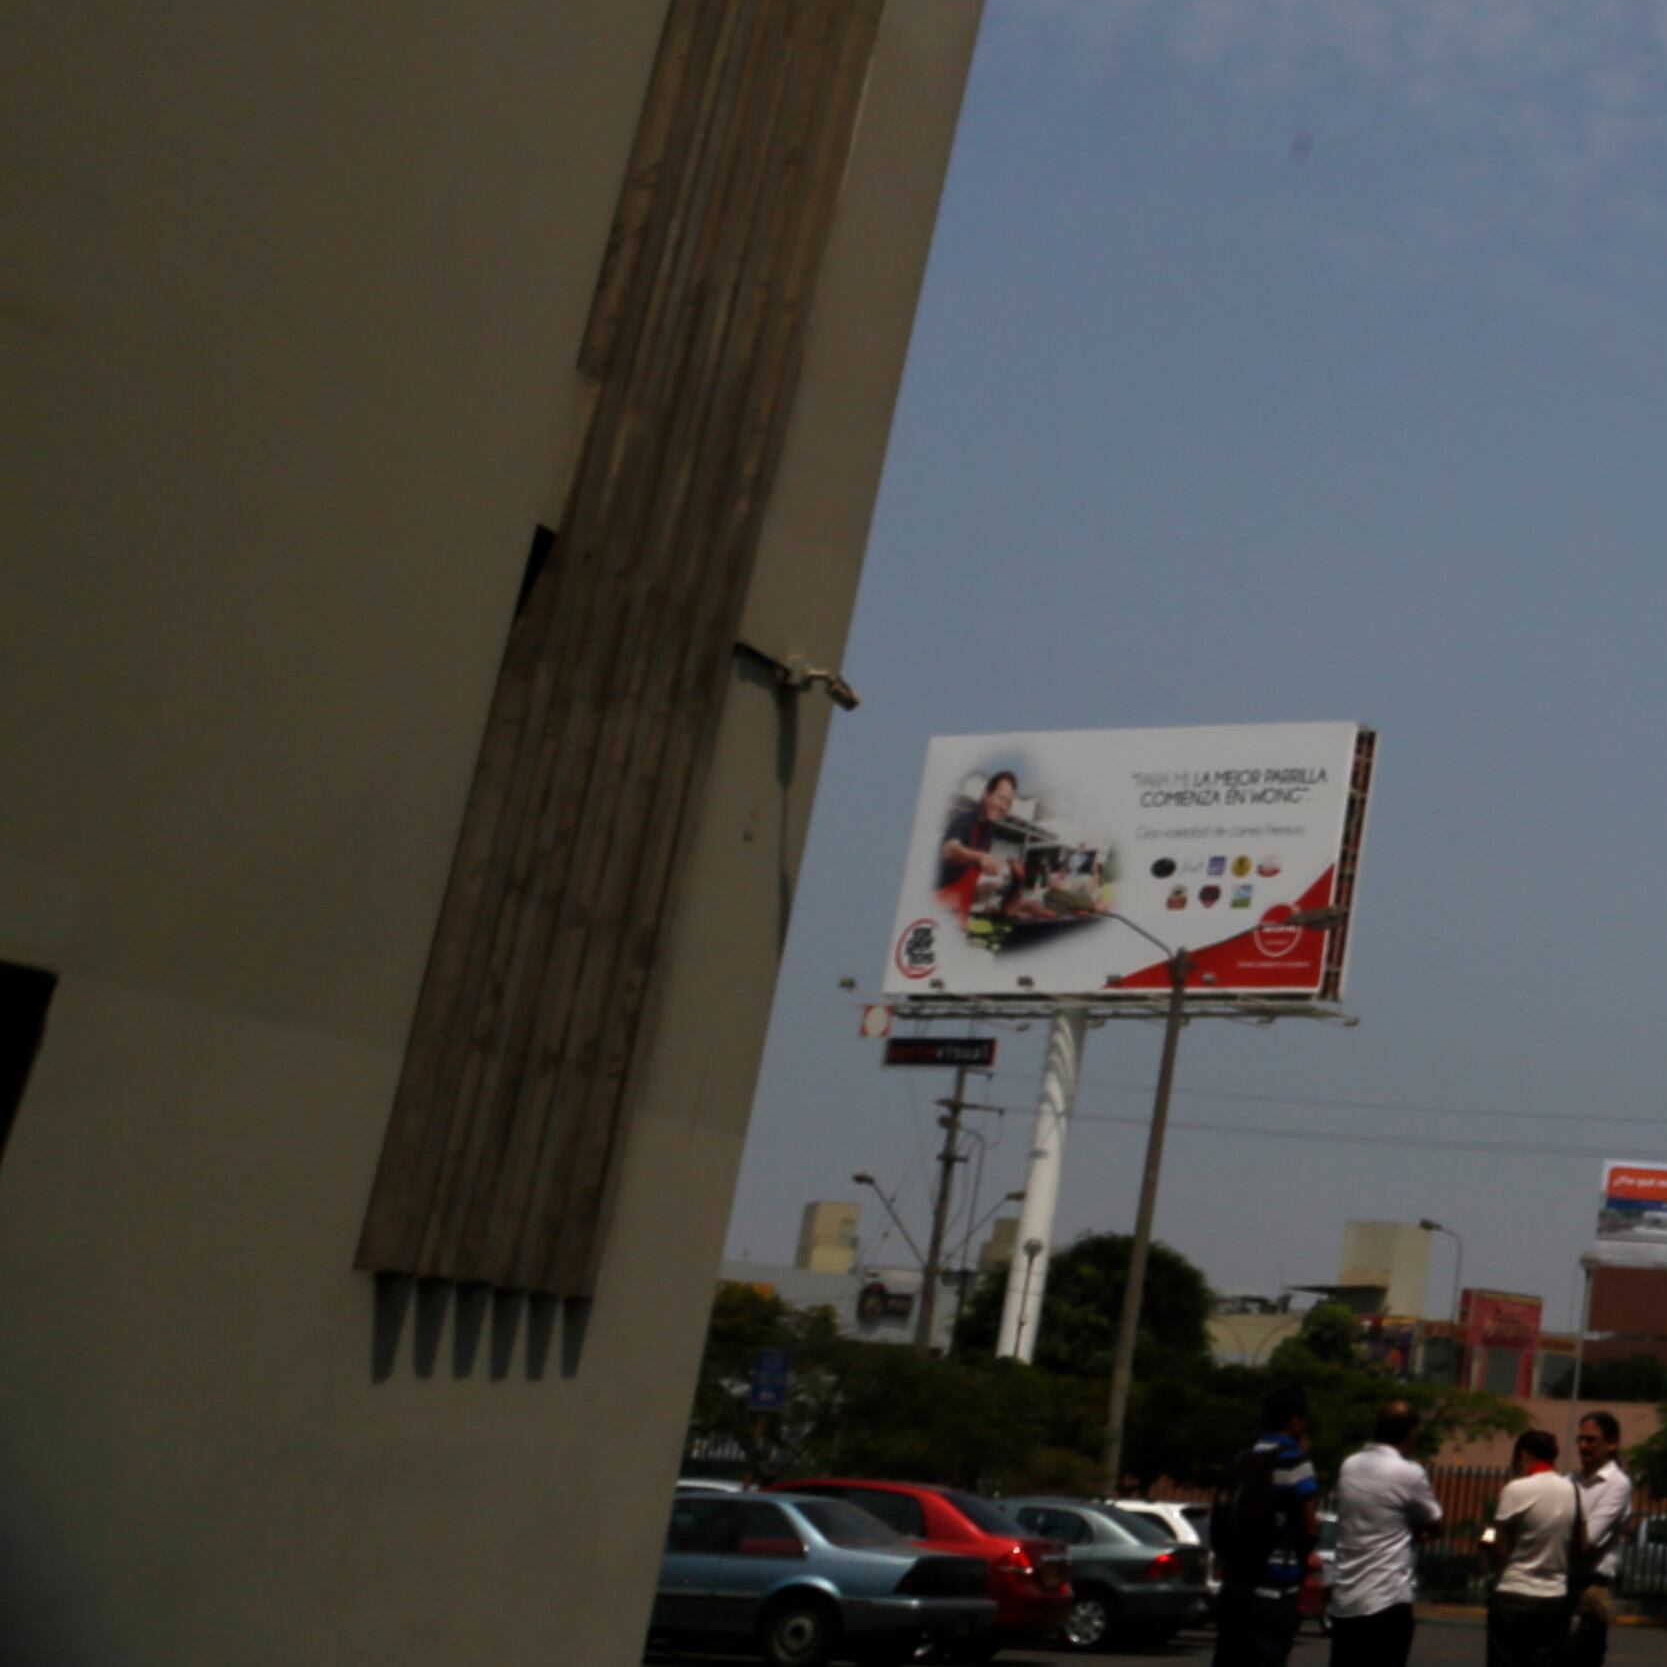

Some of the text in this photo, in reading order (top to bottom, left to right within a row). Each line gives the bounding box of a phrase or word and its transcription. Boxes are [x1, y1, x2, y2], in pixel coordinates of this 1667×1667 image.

[1193, 772, 1211, 788] LA
[1215, 769, 1260, 787] MEJOR
[1264, 767, 1328, 785] PARRILLA
[1140, 789, 1220, 808] COMIENZA
[1224, 789, 1246, 806] EN
